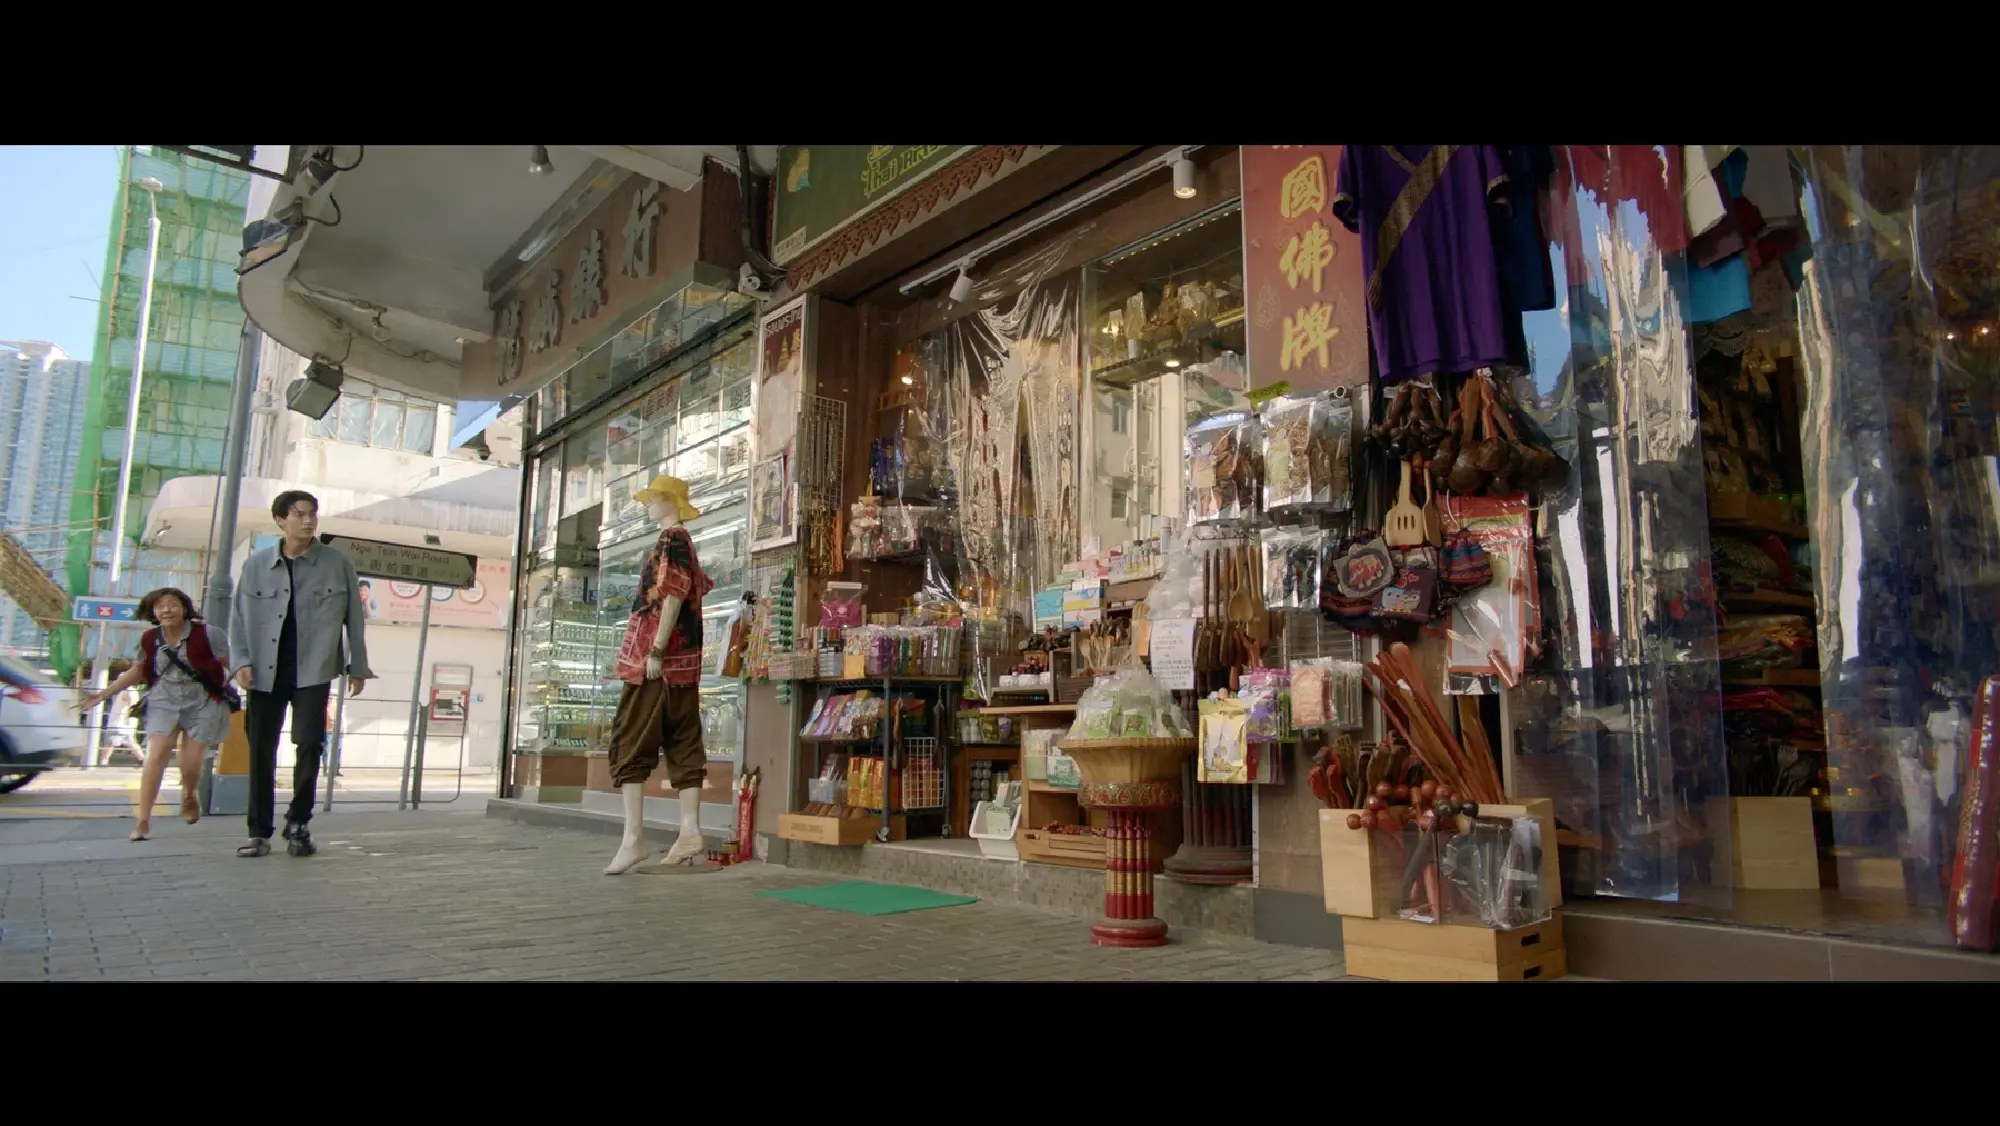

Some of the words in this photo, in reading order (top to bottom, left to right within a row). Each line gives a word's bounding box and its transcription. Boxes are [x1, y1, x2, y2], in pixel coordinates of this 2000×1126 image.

[1271, 145, 1339, 372] 國佛牌
[350, 542, 372, 555] Nga
[377, 545, 398, 558] Tsin
[401, 548, 421, 561] Wai
[422, 551, 450, 565] Road
